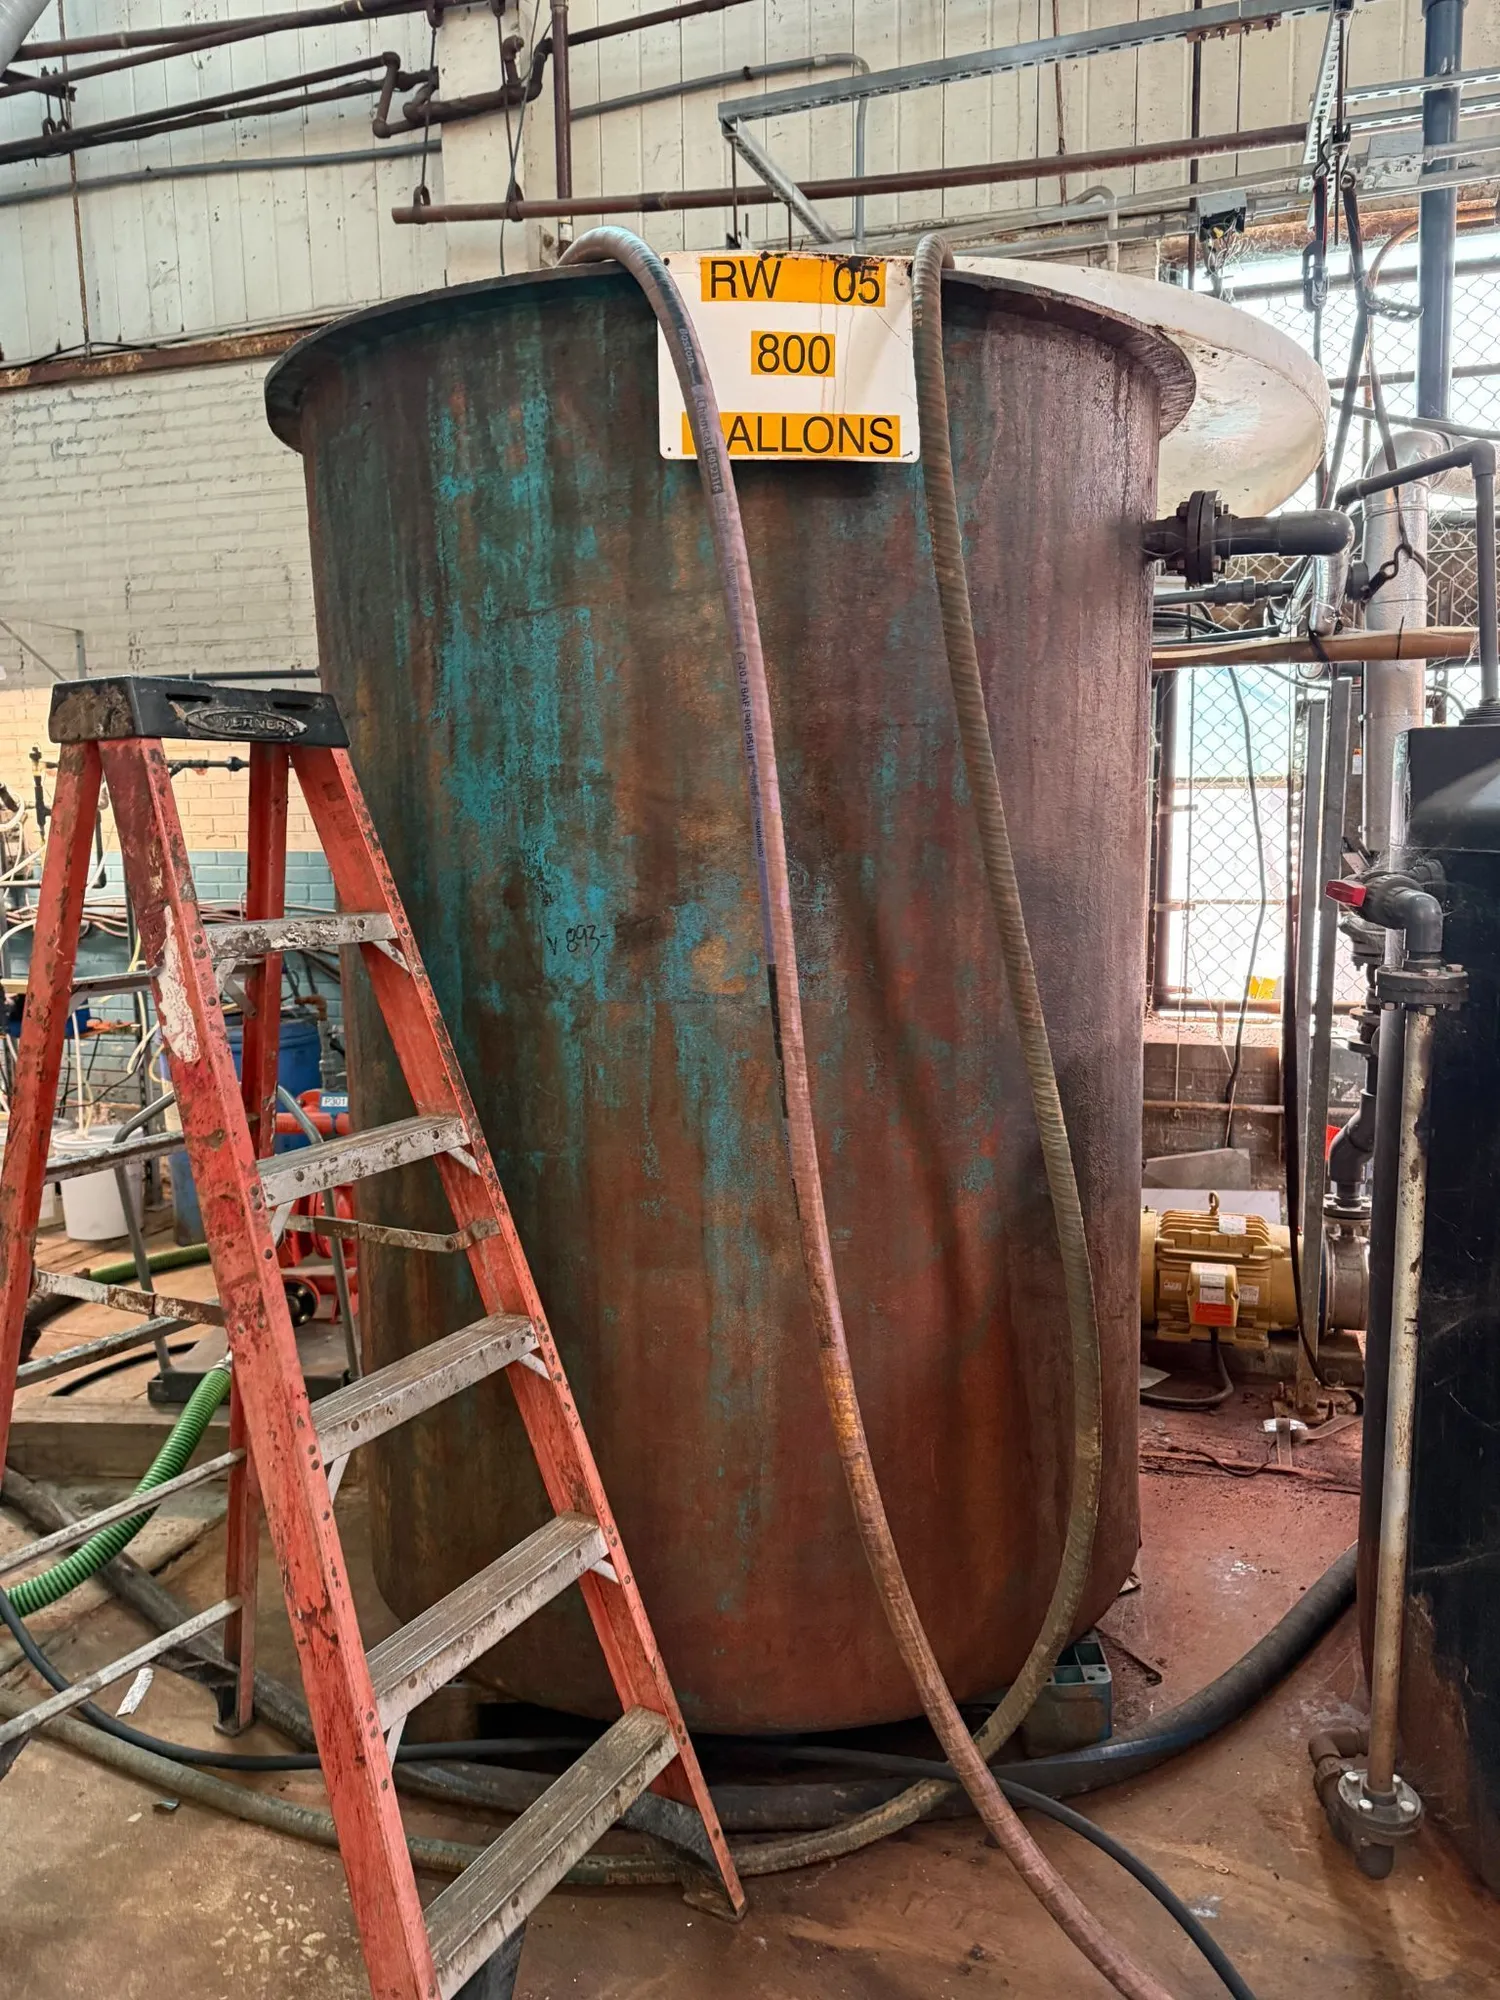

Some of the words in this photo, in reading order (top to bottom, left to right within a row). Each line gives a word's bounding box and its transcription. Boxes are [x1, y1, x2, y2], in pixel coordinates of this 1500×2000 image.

[710, 259, 783, 299] RW
[832, 262, 881, 305] 05
[756, 333, 831, 375] 800
[727, 414, 894, 455] ALLONS
[323, 1096, 346, 1106] P301
